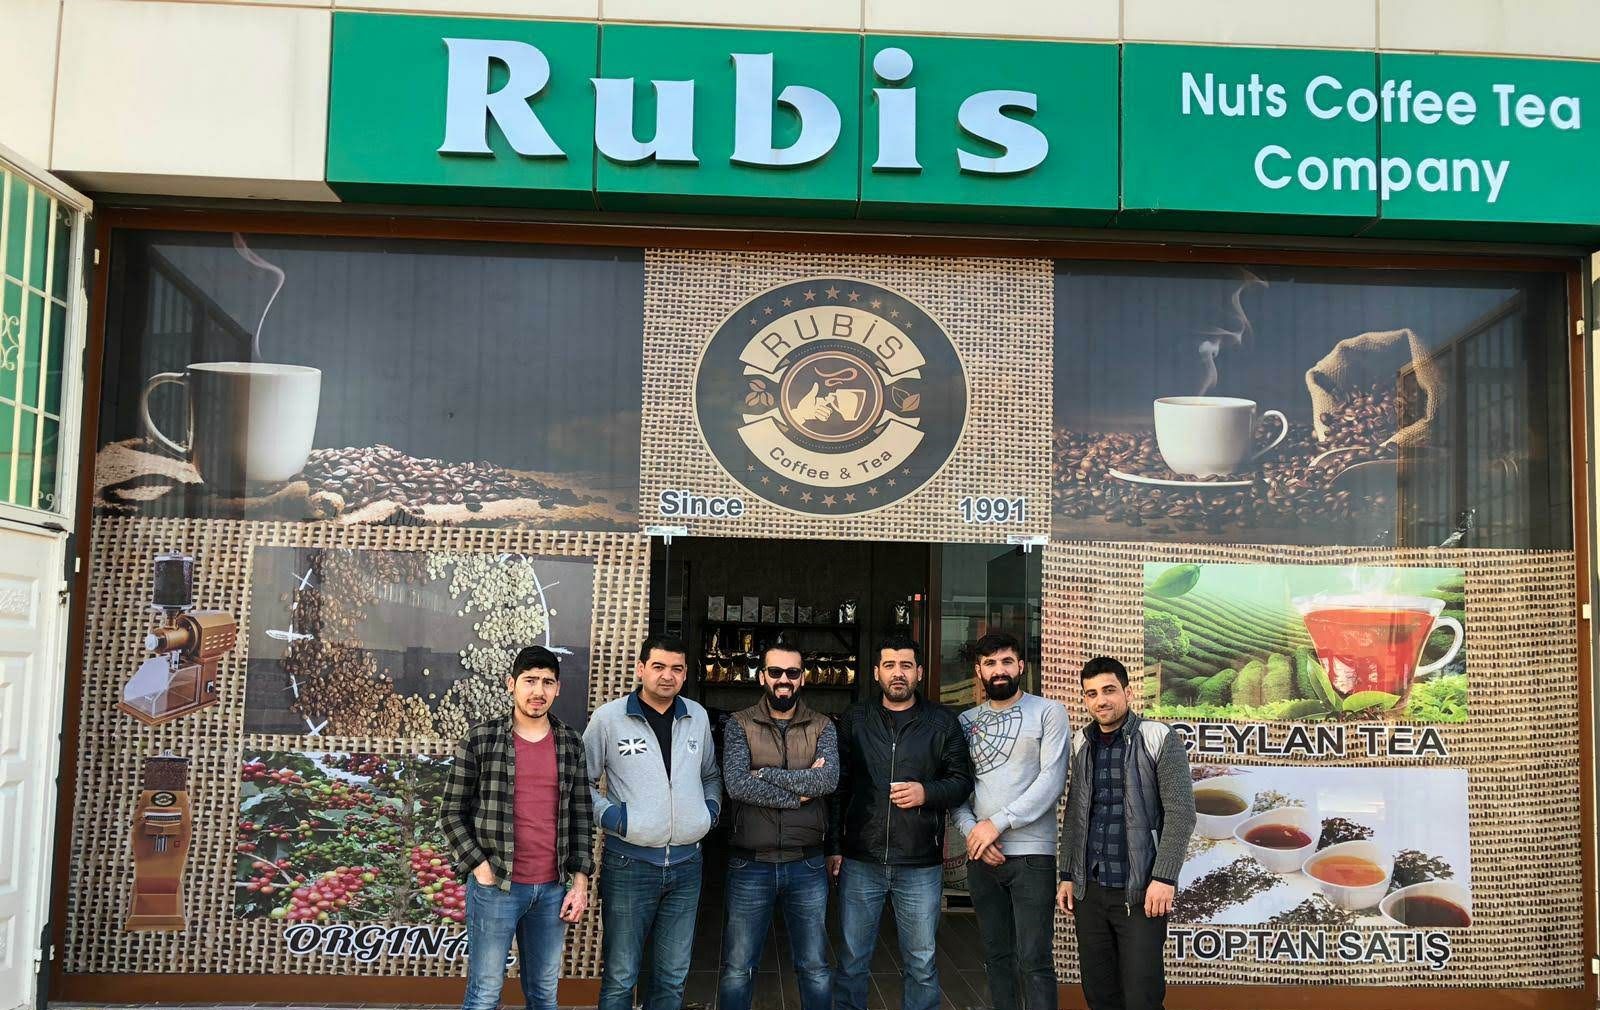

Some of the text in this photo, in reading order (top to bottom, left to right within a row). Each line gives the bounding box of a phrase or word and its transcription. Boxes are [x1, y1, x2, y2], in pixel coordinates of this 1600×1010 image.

[436, 37, 1050, 176] Rubis
[1181, 72, 1581, 130] Nuts Coffee Tea
[1254, 144, 1510, 203] Company
[769, 446, 893, 481] Coffee & Tea
[659, 490, 1026, 523] Since 1991
[1170, 722, 1449, 758] CEYLAN TEA
[284, 923, 517, 967] ORGINA
[1168, 928, 1451, 970] TOPTAN SATIŞ
